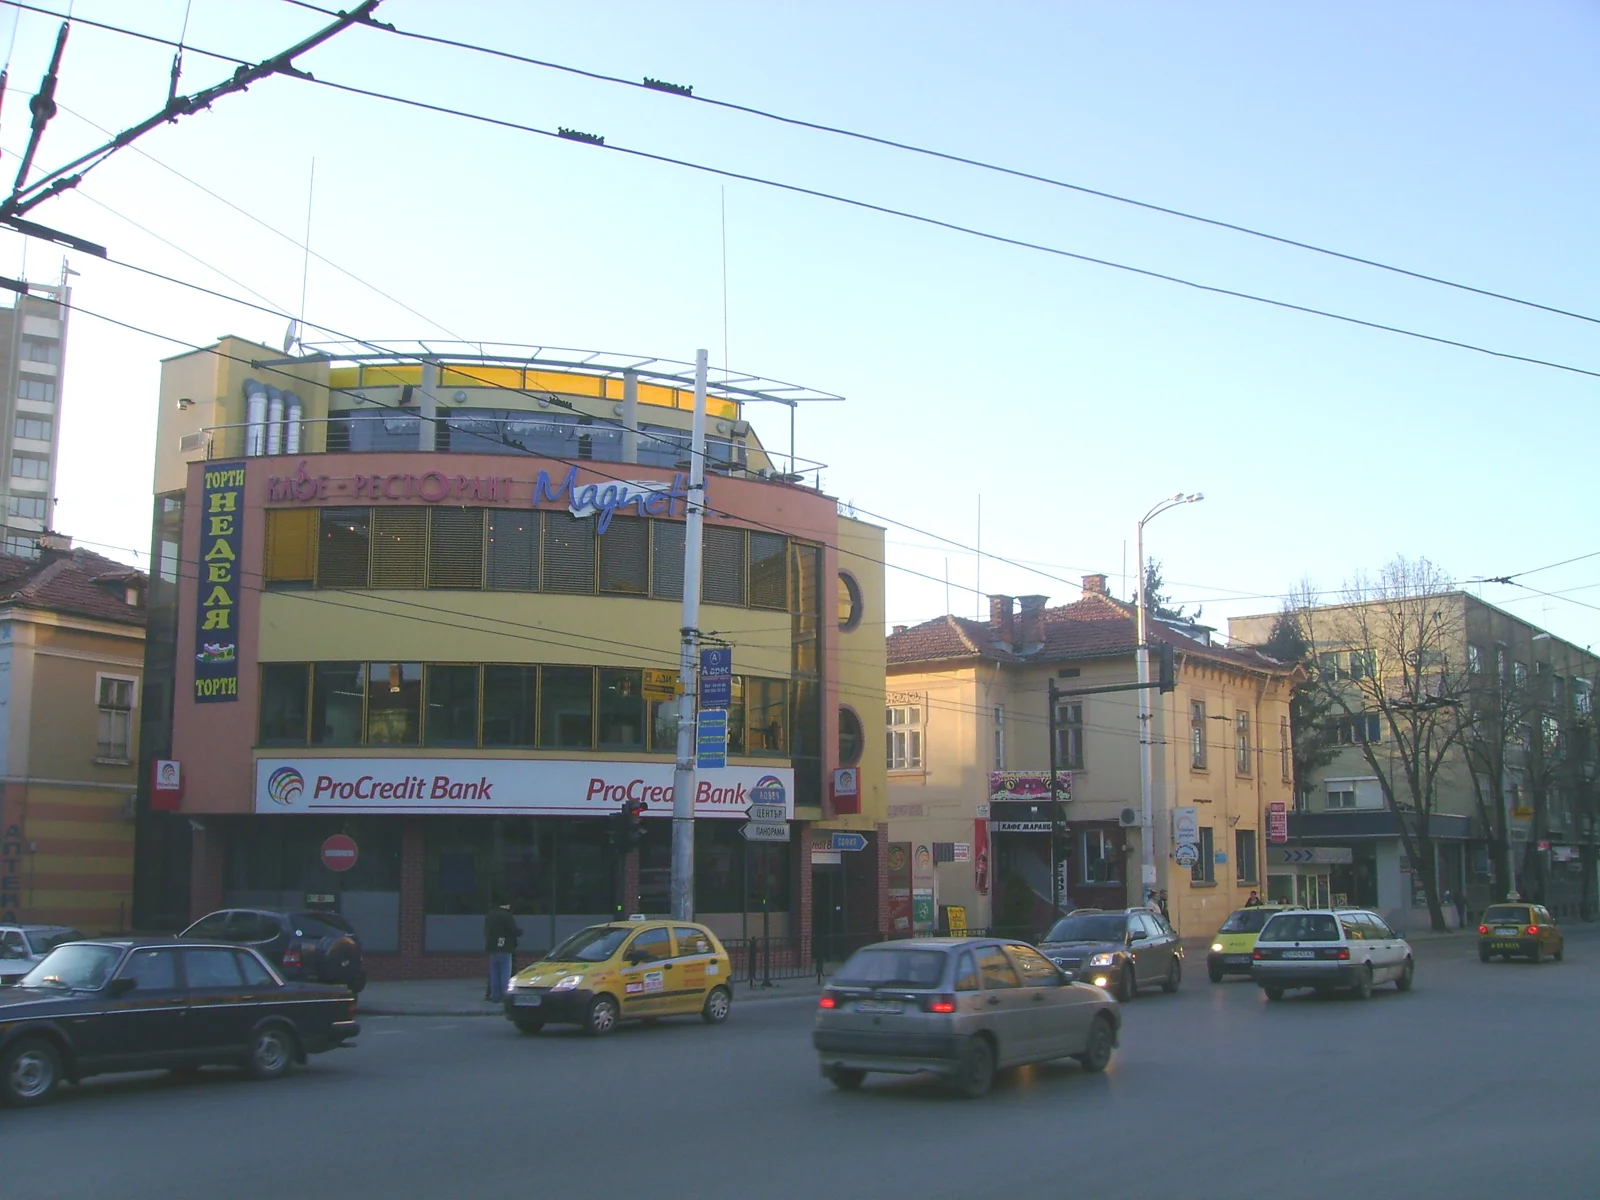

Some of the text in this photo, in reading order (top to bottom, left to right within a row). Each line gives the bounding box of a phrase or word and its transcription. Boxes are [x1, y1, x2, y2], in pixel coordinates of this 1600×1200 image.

[205, 469, 245, 489] ТОРТИ
[533, 464, 715, 535] Magnet
[201, 491, 238, 630] НЕДЕЛЯ
[195, 677, 237, 697] ТОРТИ
[313, 775, 494, 800] ProCredit Bank
[695, 781, 747, 804] Bank
[756, 808, 783, 819] ЦЕНТЪР
[755, 827, 786, 837] ПАНОРАМА
[1001, 823, 1022, 831] КАФЕ
